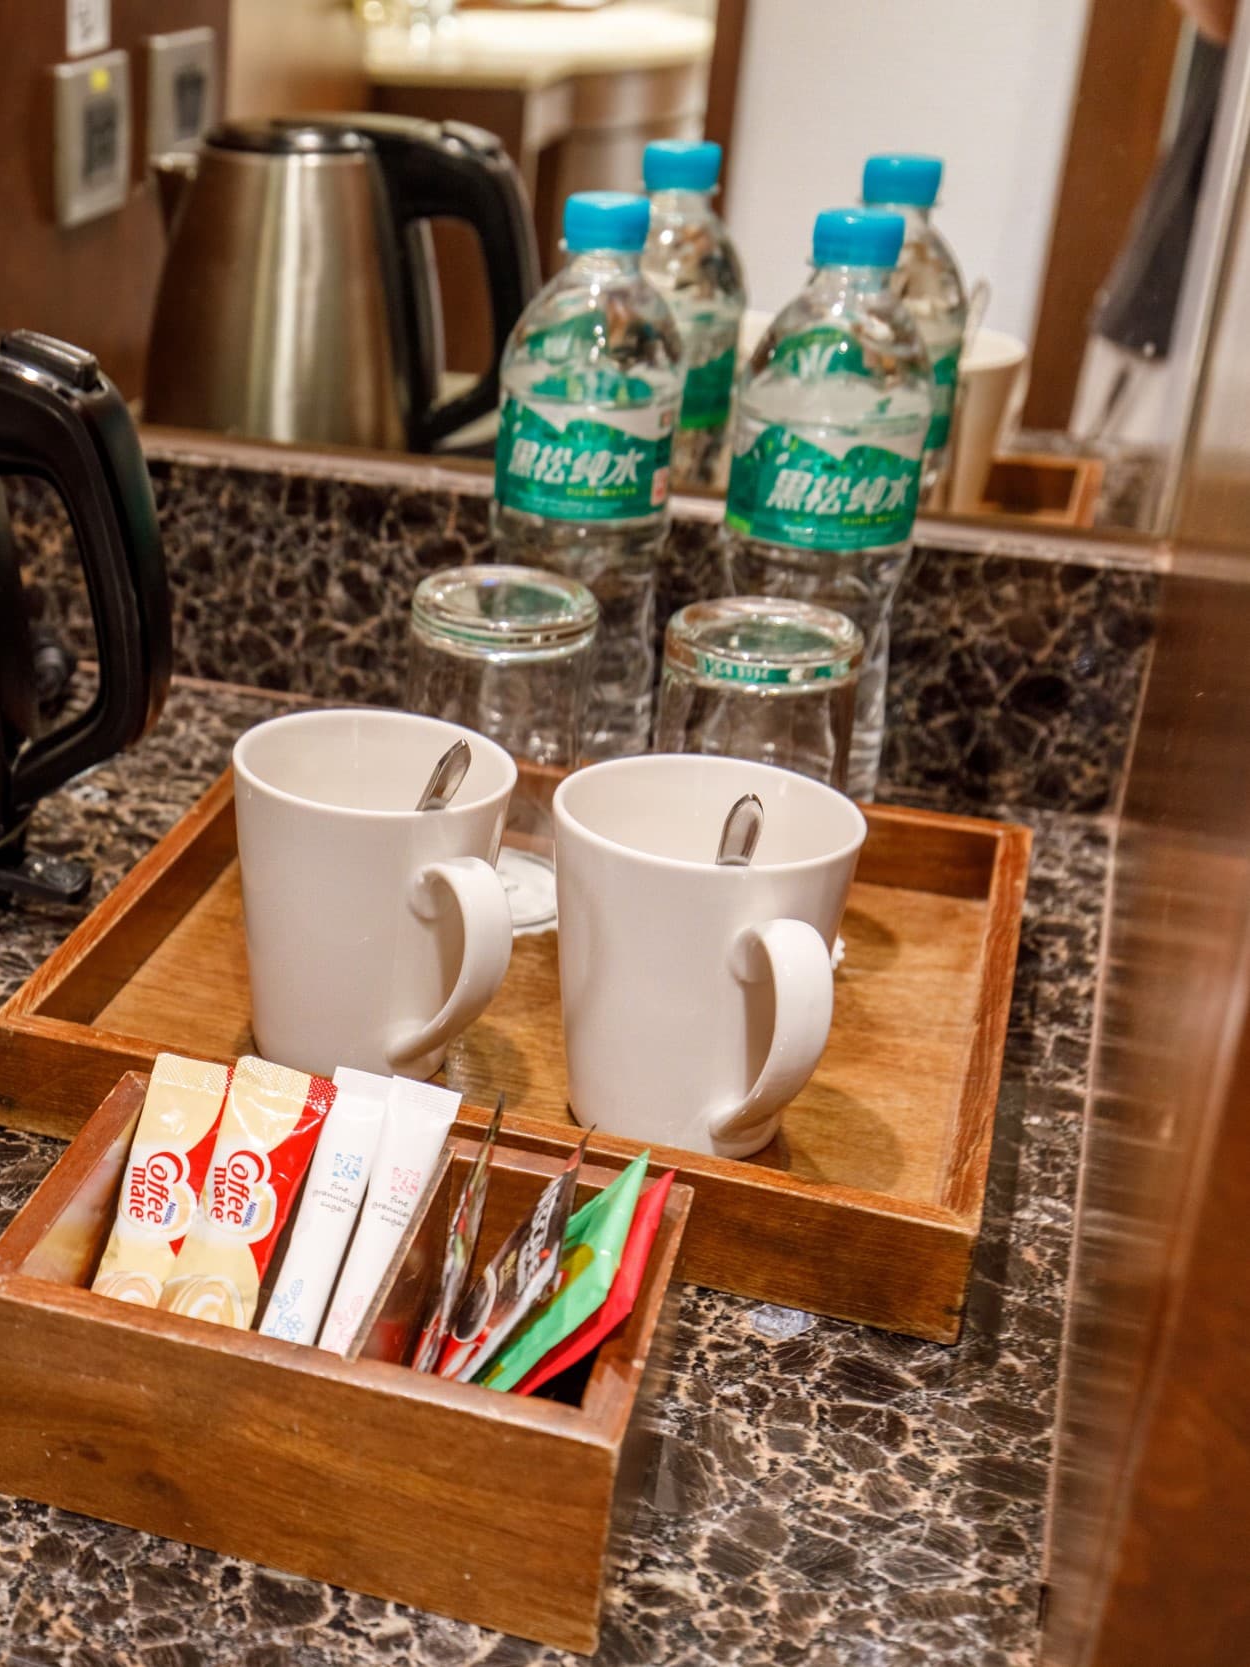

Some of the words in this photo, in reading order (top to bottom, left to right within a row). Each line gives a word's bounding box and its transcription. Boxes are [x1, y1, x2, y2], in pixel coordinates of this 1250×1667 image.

[129, 1166, 146, 1219] mate
[147, 1151, 184, 1225] Coffee
[210, 1167, 227, 1220] mate
[227, 1150, 265, 1225] Coffee
[390, 1194, 409, 1208] fine
